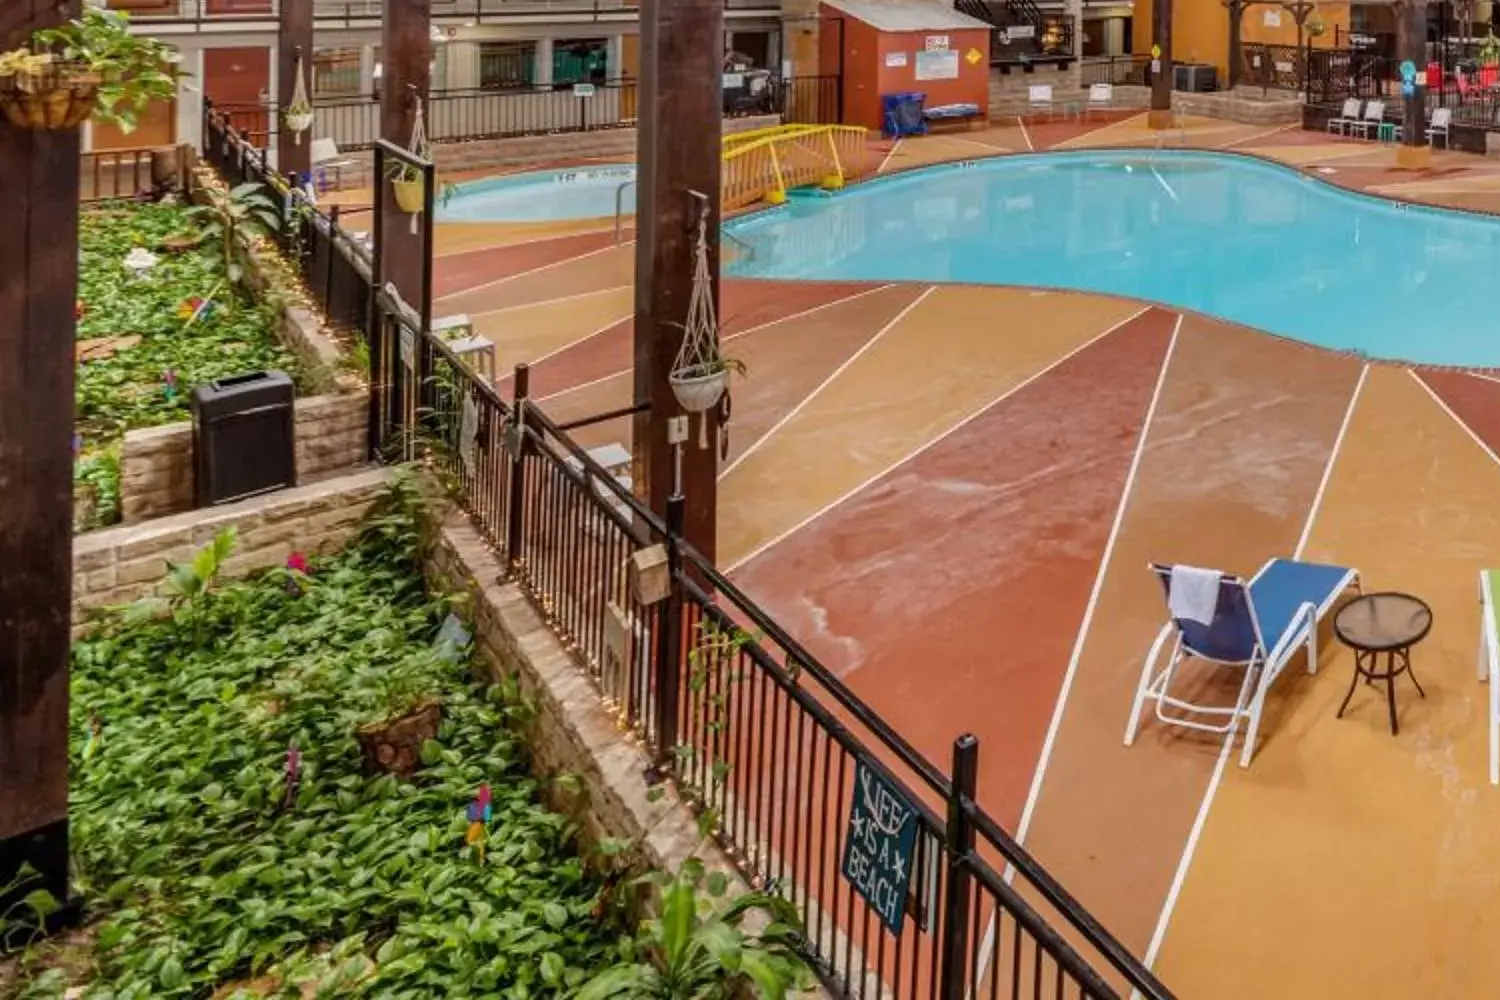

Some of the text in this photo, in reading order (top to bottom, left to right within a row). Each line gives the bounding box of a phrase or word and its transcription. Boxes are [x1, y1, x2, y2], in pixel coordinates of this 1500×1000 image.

[860, 765, 911, 835] LIFE
[863, 819, 889, 870] IS A
[847, 845, 899, 924] BEACH
